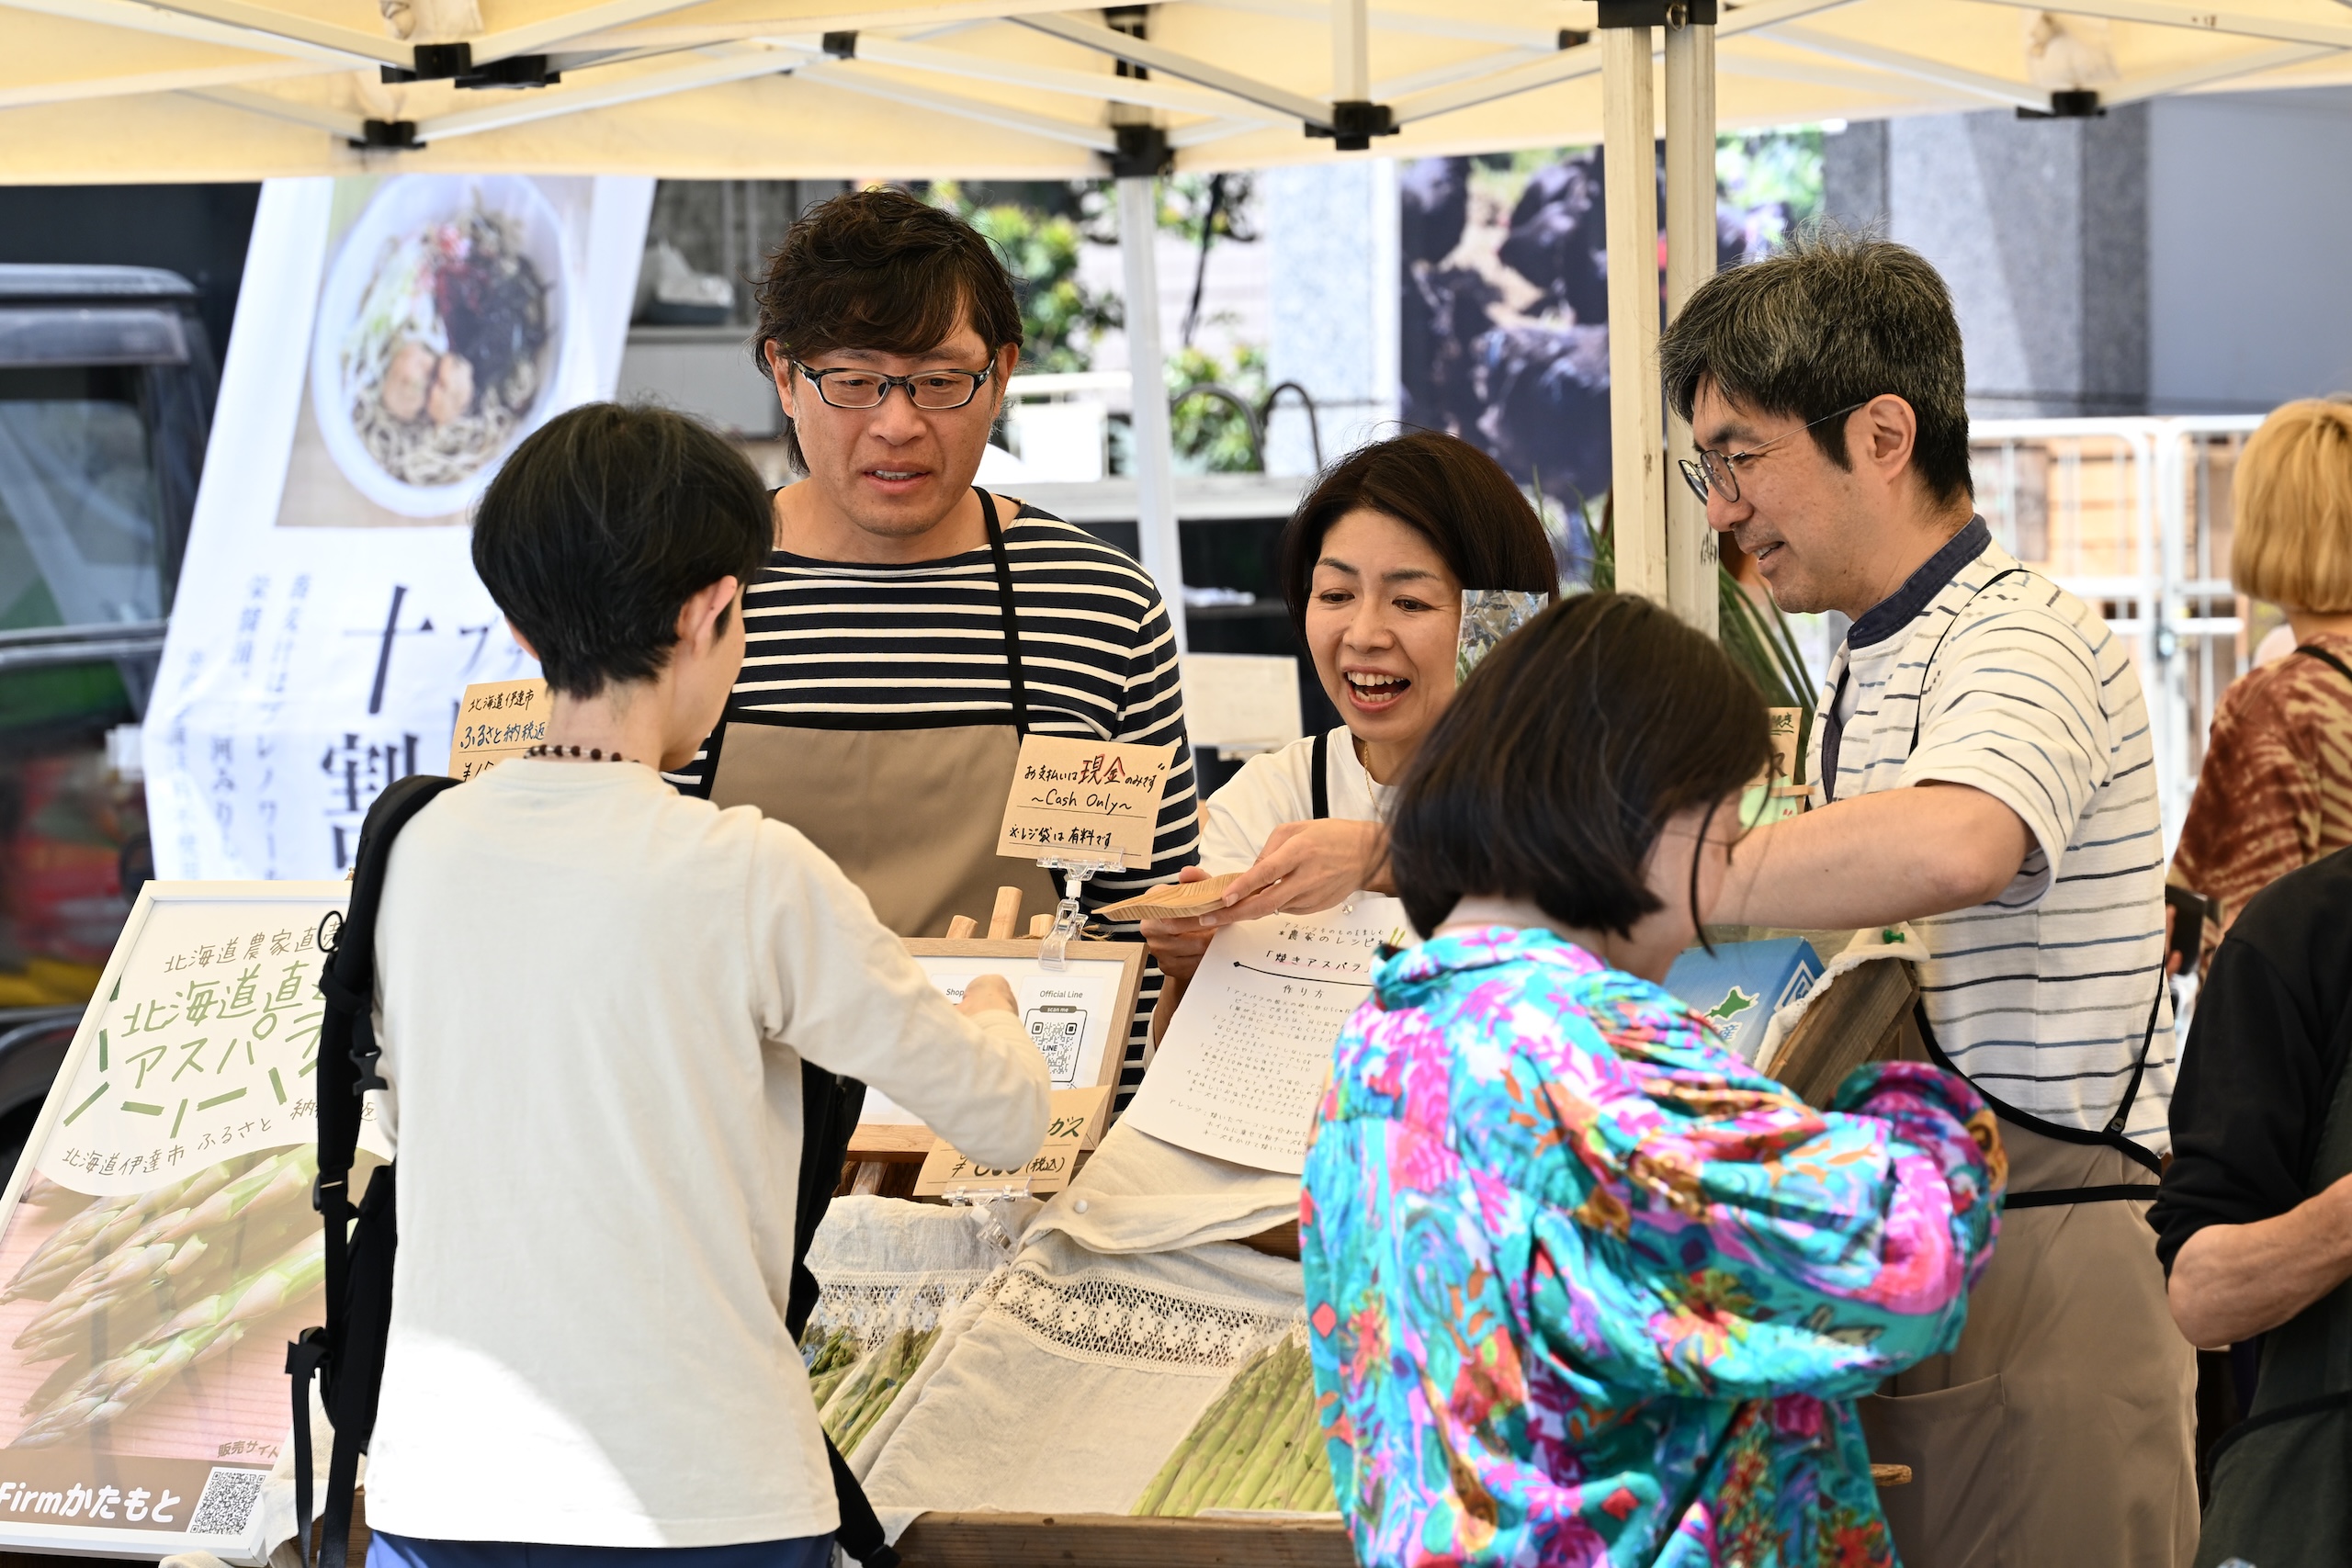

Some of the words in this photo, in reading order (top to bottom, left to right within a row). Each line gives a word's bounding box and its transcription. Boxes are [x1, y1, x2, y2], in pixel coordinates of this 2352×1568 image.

[468, 688, 535, 713] 北海道伊達市
[120, 960, 327, 1038] 北海道直
[945, 987, 965, 1003] Shop
[1039, 989, 1067, 998] Official
[1067, 990, 1084, 999] Line
[1282, 984, 1325, 999] 作り方
[125, 1010, 324, 1089] アスパラ
[1042, 1044, 1058, 1053] LINE
[62, 1144, 186, 1176] 北海道伊達市
[197, 1118, 273, 1151] ふるさと
[217, 1439, 279, 1459] 販売サイト
